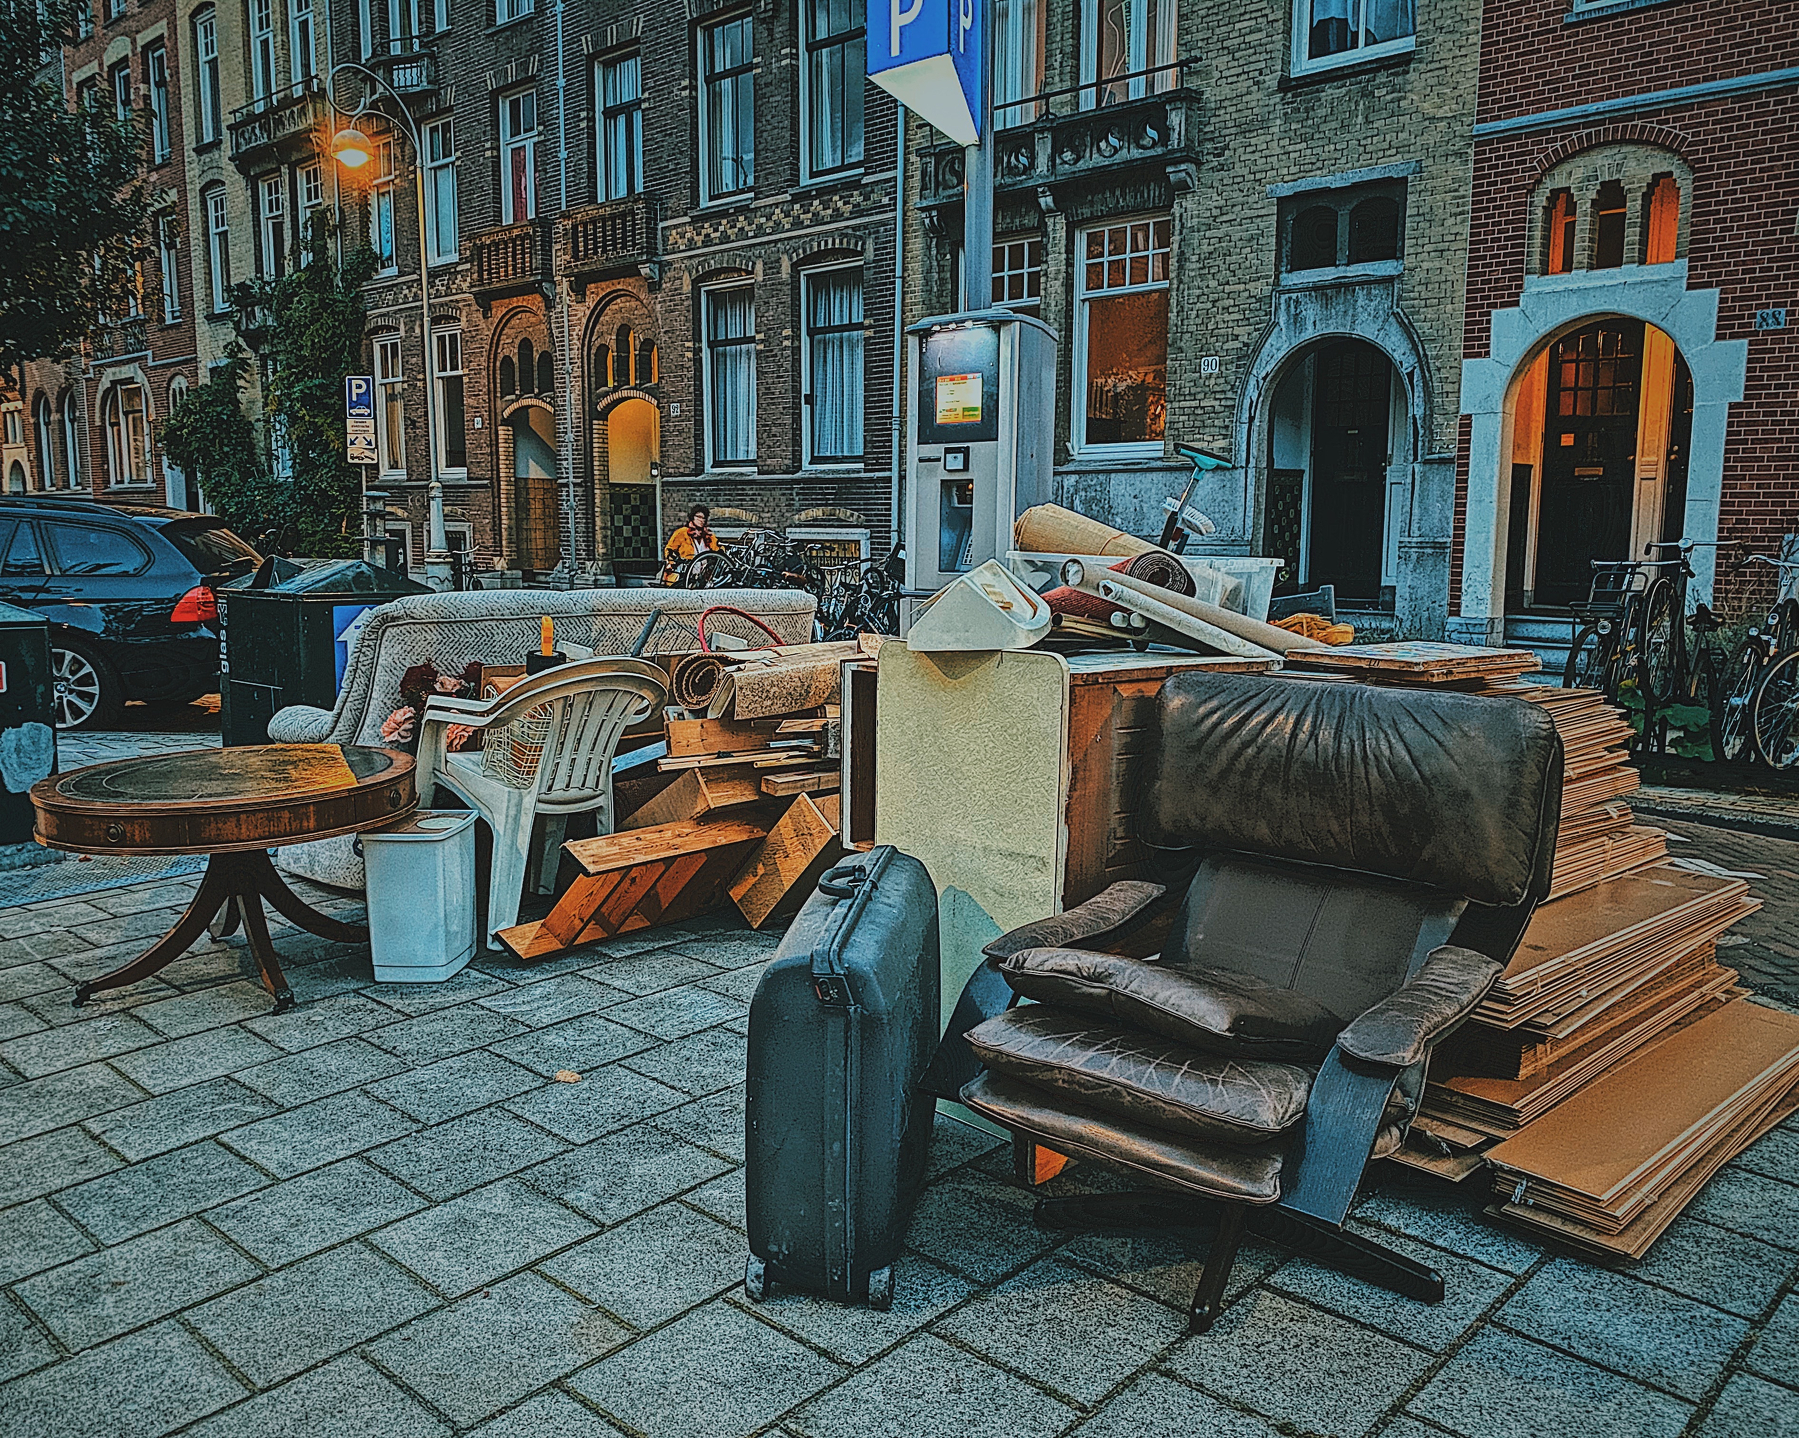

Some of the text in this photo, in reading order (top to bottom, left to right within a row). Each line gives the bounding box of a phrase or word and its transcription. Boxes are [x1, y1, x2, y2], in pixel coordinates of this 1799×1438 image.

[890, 0, 923, 57] P
[959, 0, 973, 55] P
[1203, 358, 1218, 371] 90
[351, 380, 367, 401] P
[219, 629, 230, 673] glas
